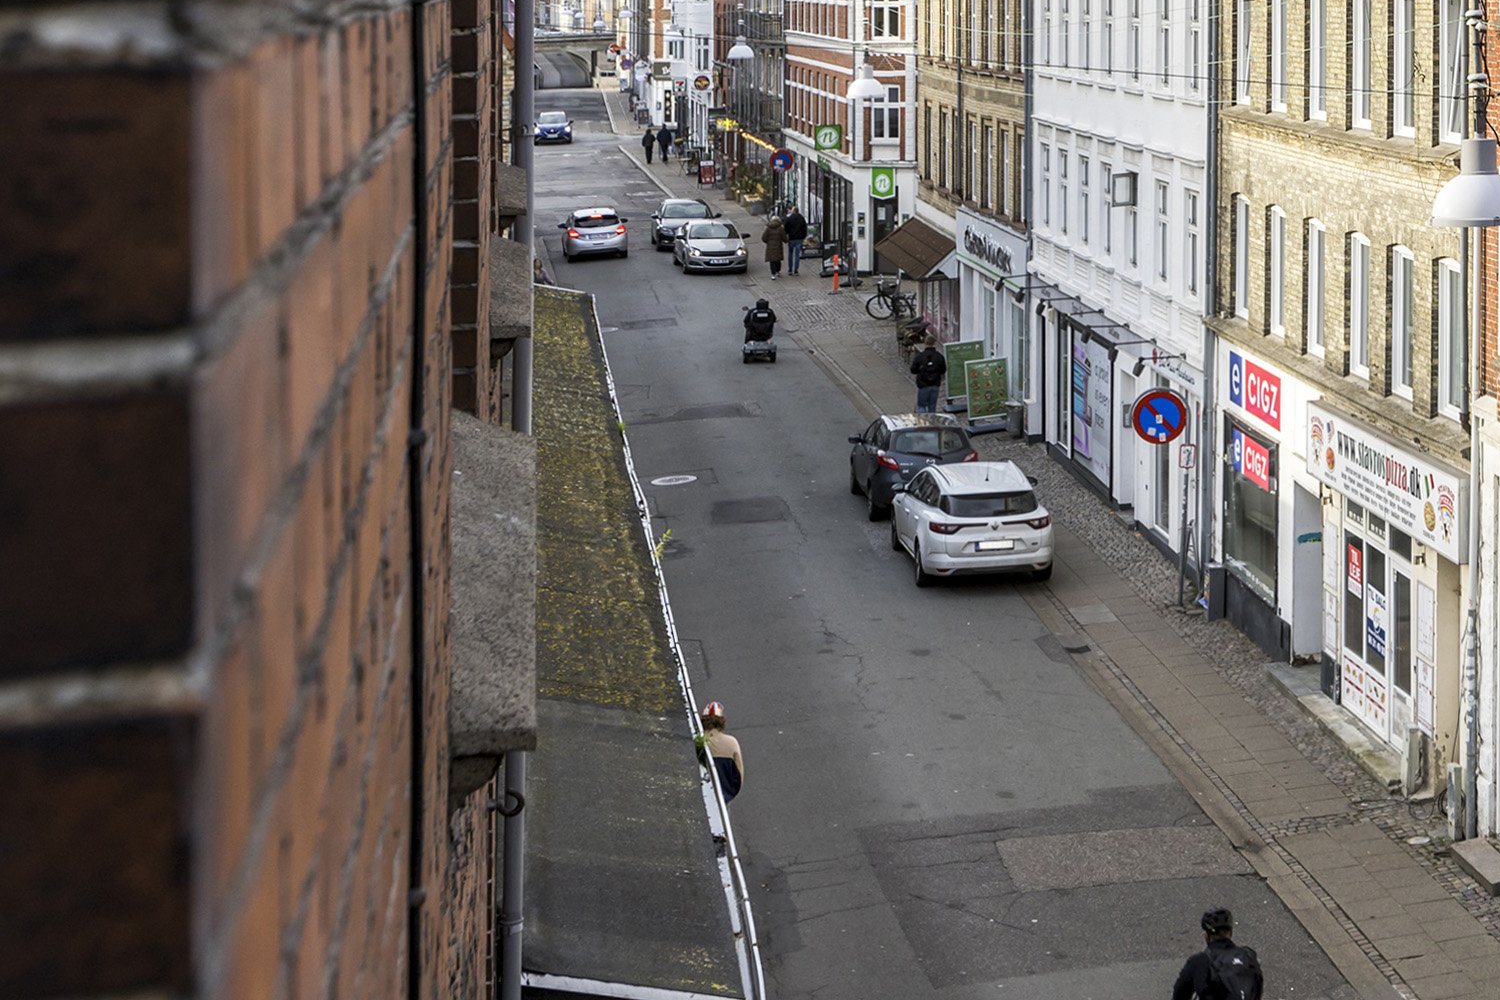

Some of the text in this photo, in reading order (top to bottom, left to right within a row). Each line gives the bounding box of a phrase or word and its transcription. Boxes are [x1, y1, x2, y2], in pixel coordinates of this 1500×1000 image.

[1247, 372, 1279, 420] CIGZ
[1245, 446, 1268, 482] CIGZ
[1336, 429, 1422, 501] www.stavrospizza.dk
